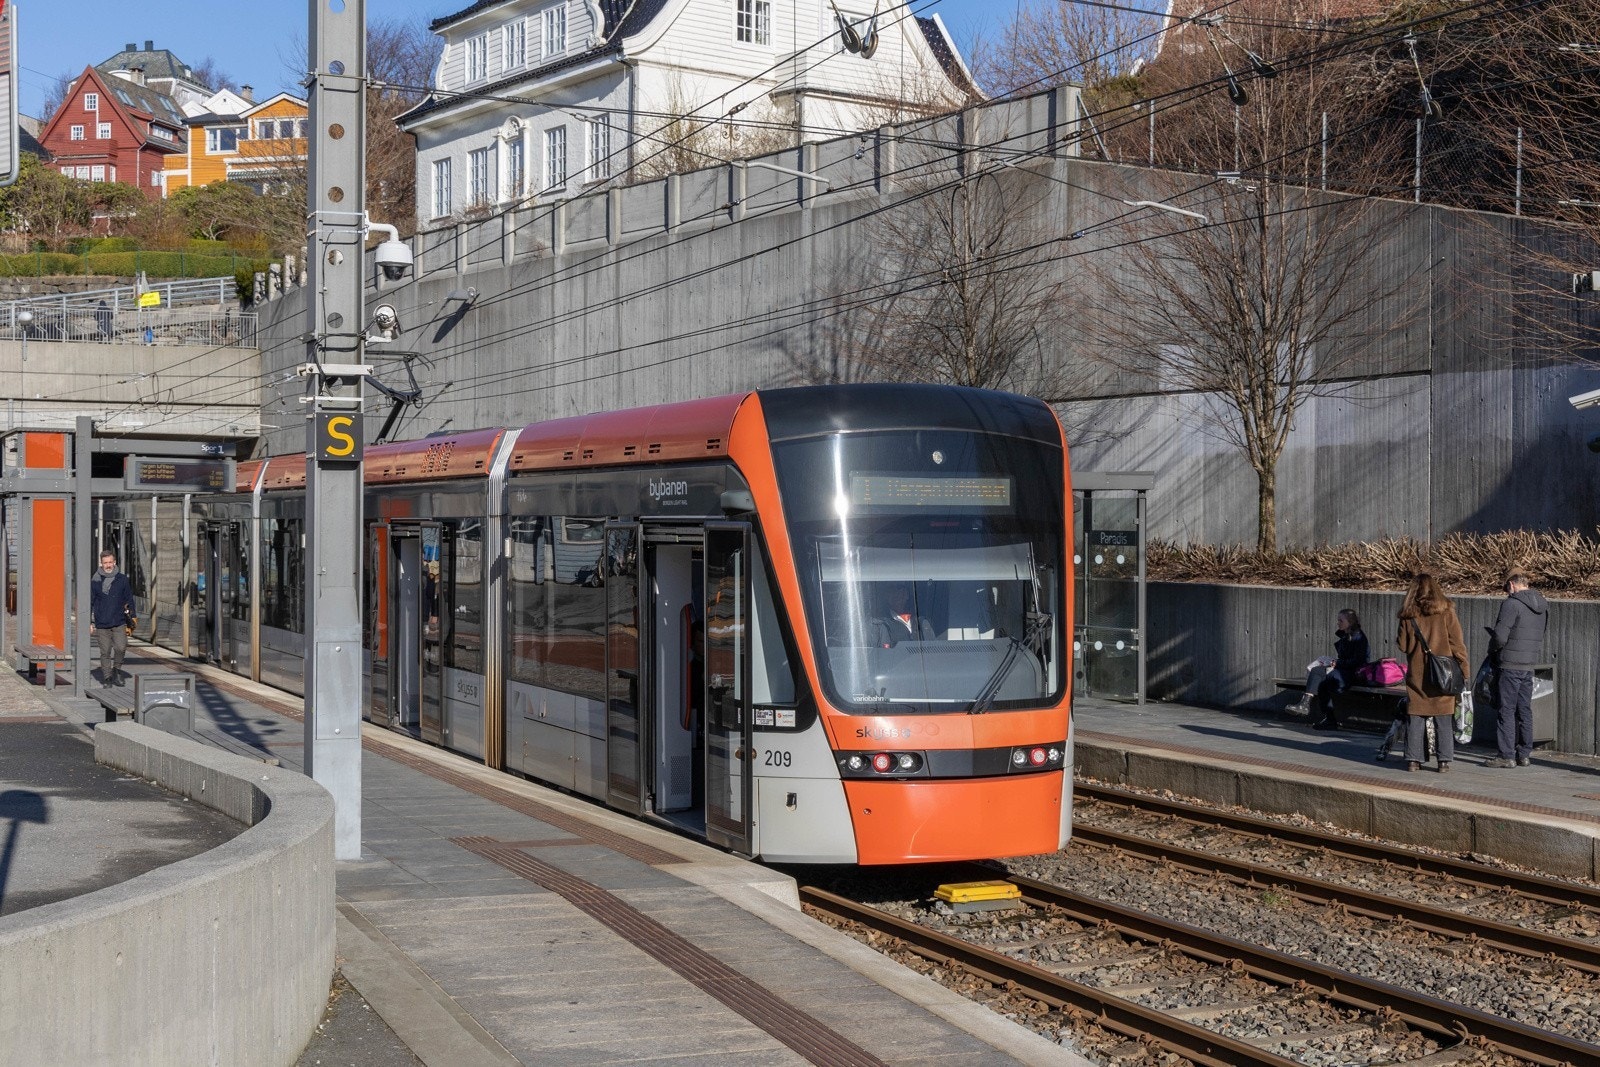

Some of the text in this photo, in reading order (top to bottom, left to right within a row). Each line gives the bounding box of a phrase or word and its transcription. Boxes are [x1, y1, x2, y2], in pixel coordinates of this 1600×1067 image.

[326, 416, 355, 456] S
[201, 444, 224, 454] Spor 1
[649, 477, 688, 500] bybanen
[1100, 531, 1127, 544] Paradis
[852, 694, 884, 702] variobahn
[856, 726, 899, 740] skyss
[765, 750, 791, 767] 209
